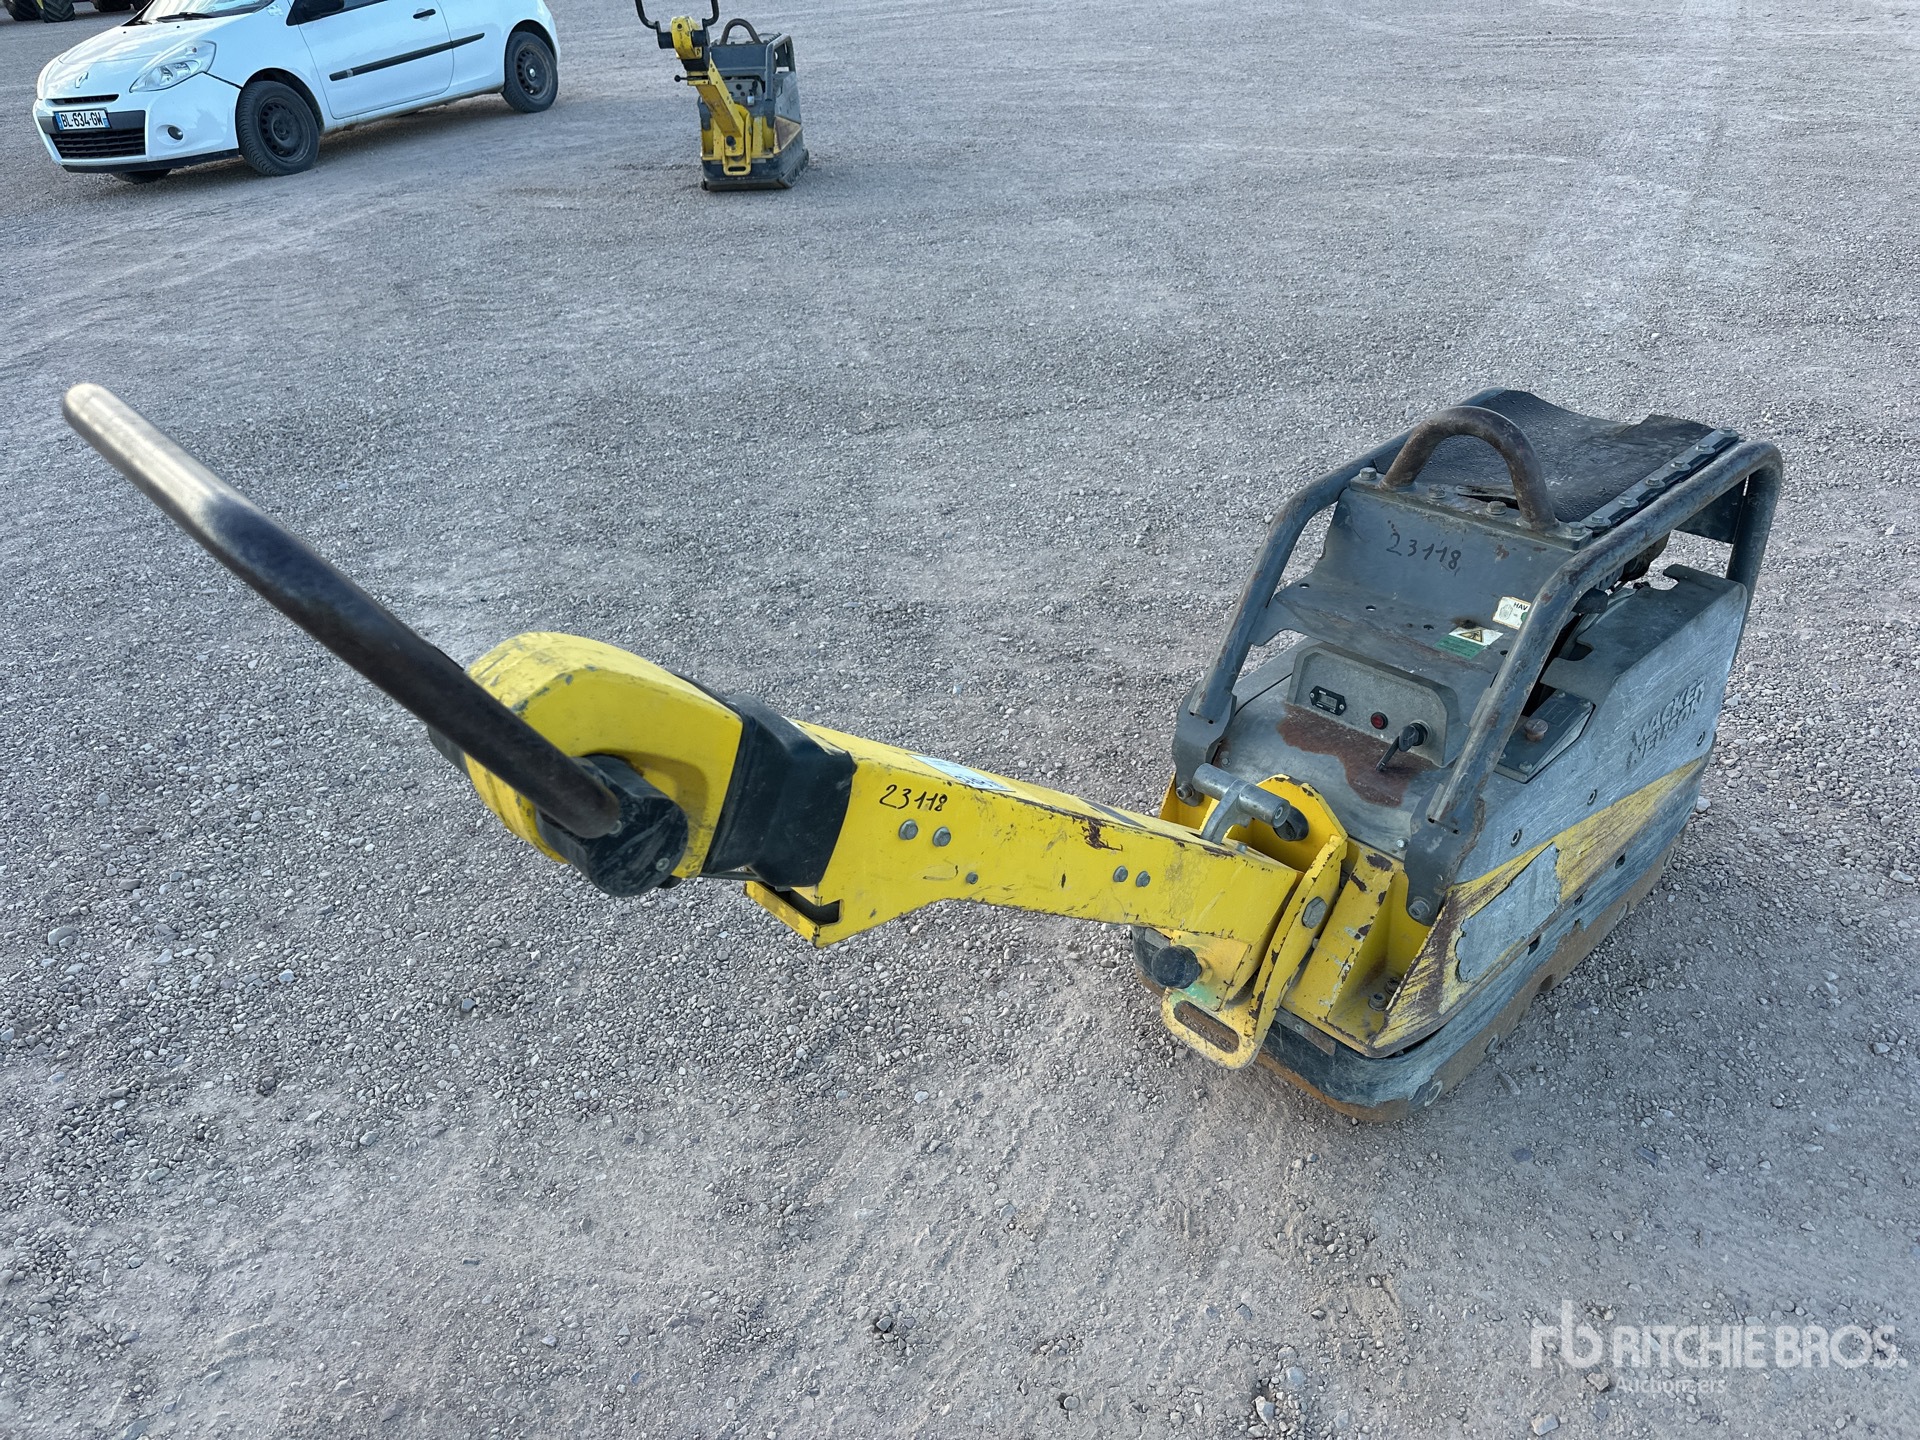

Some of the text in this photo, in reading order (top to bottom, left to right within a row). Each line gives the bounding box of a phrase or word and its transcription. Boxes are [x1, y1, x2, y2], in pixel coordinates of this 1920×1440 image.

[60, 111, 104, 128] BL-634-GW
[1386, 532, 1462, 570] 23118
[879, 784, 948, 812] 23118
